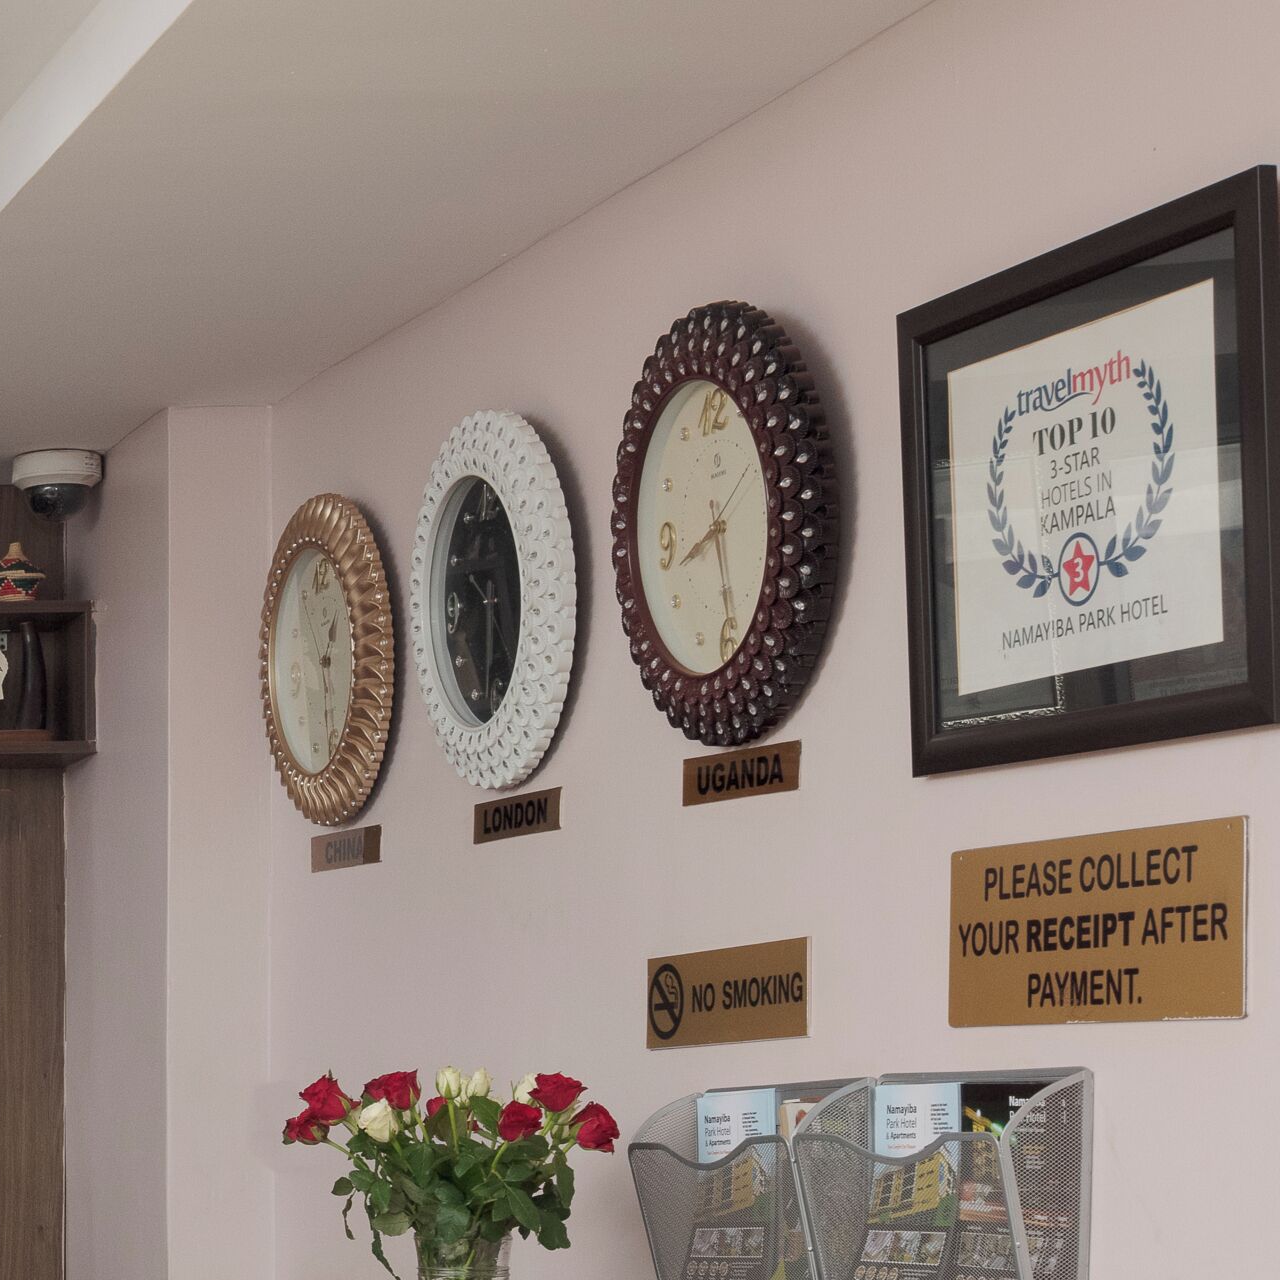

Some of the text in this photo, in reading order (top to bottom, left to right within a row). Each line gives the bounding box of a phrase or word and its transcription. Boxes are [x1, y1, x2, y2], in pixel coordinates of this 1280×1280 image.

[1016, 349, 1131, 415] travelmyth
[698, 387, 728, 437] 12
[1033, 407, 1116, 456] TOP 10
[1050, 447, 1101, 478] 3-STAR
[1041, 470, 1112, 508] HOTELS IN
[1041, 499, 1116, 535] KAMPALA
[659, 521, 676, 570] 9
[1072, 558, 1084, 584] 3
[1002, 595, 1168, 650] NAMAYIBA PARK HOTEL
[696, 753, 784, 796] UGANDA
[483, 798, 549, 835] LONDON
[325, 835, 363, 864] CHINA
[983, 844, 1198, 901] PLEASE COLLECT
[958, 902, 1228, 958] YOUR RECEIPT AFTER
[692, 971, 804, 1013] NO SMOKING
[1027, 967, 1143, 1009] PAYMENT.
[704, 1113, 731, 1124] Namayiba
[886, 1103, 917, 1116] Namayiba
[886, 1117, 917, 1129] Park Hotel
[704, 1126, 731, 1136] Park Hotel
[891, 1131, 917, 1140] Apartments
